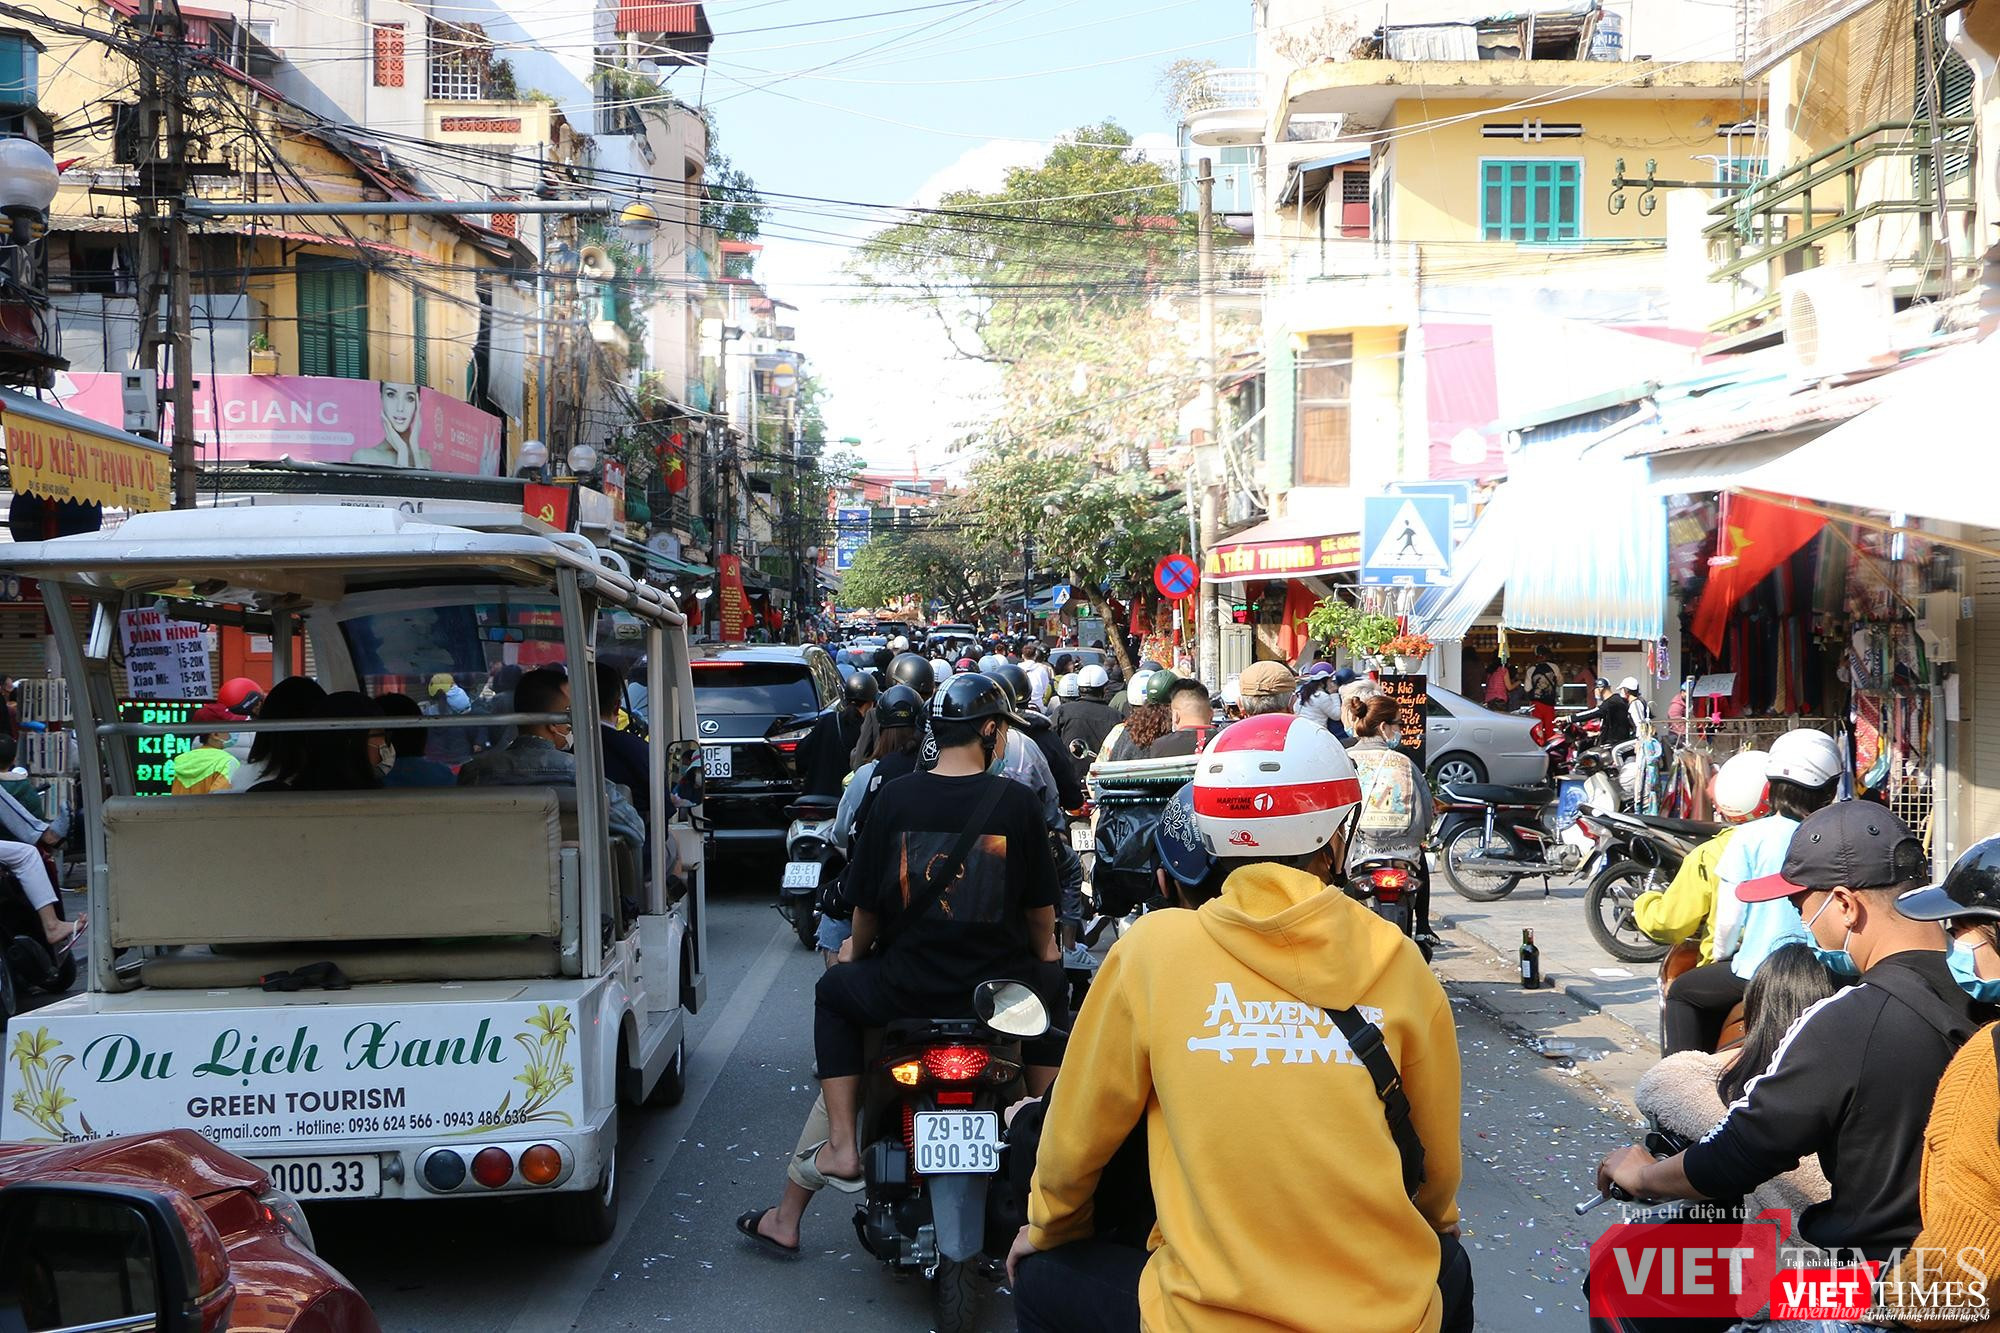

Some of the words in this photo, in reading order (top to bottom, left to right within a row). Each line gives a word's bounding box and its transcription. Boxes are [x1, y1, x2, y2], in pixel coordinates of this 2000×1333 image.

[223, 400, 339, 425] GIANG
[8, 426, 44, 478] PHỤ
[49, 431, 89, 484] KIỆN
[176, 640, 203, 654] 15-20K
[131, 660, 157, 672] Oppo:
[178, 656, 204, 668] 15-20K
[133, 675, 153, 687] Xiao
[180, 671, 206, 683] 15-20K
[182, 685, 208, 698] 15-20K
[138, 733, 191, 758] KIỆN
[701, 747, 721, 761] 0E
[137, 759, 175, 786] ĐIỆ
[1203, 982, 1385, 1029] ADVENRE
[82, 1033, 177, 1083] Du
[192, 1025, 324, 1087] Lịch
[343, 1017, 508, 1071] Xanh
[187, 1093, 275, 1118] GREEN
[285, 1087, 406, 1113] TOURISM
[296, 1120, 345, 1136] Hotline:
[349, 1117, 379, 1133] 0936
[383, 1115, 406, 1131] 624
[409, 1114, 432, 1130] 566
[443, 1112, 474, 1127] 0943
[477, 1110, 501, 1126] 486
[504, 1108, 528, 1124] 636
[927, 1116, 985, 1141] 29-B2
[920, 1143, 993, 1168] 090.39
